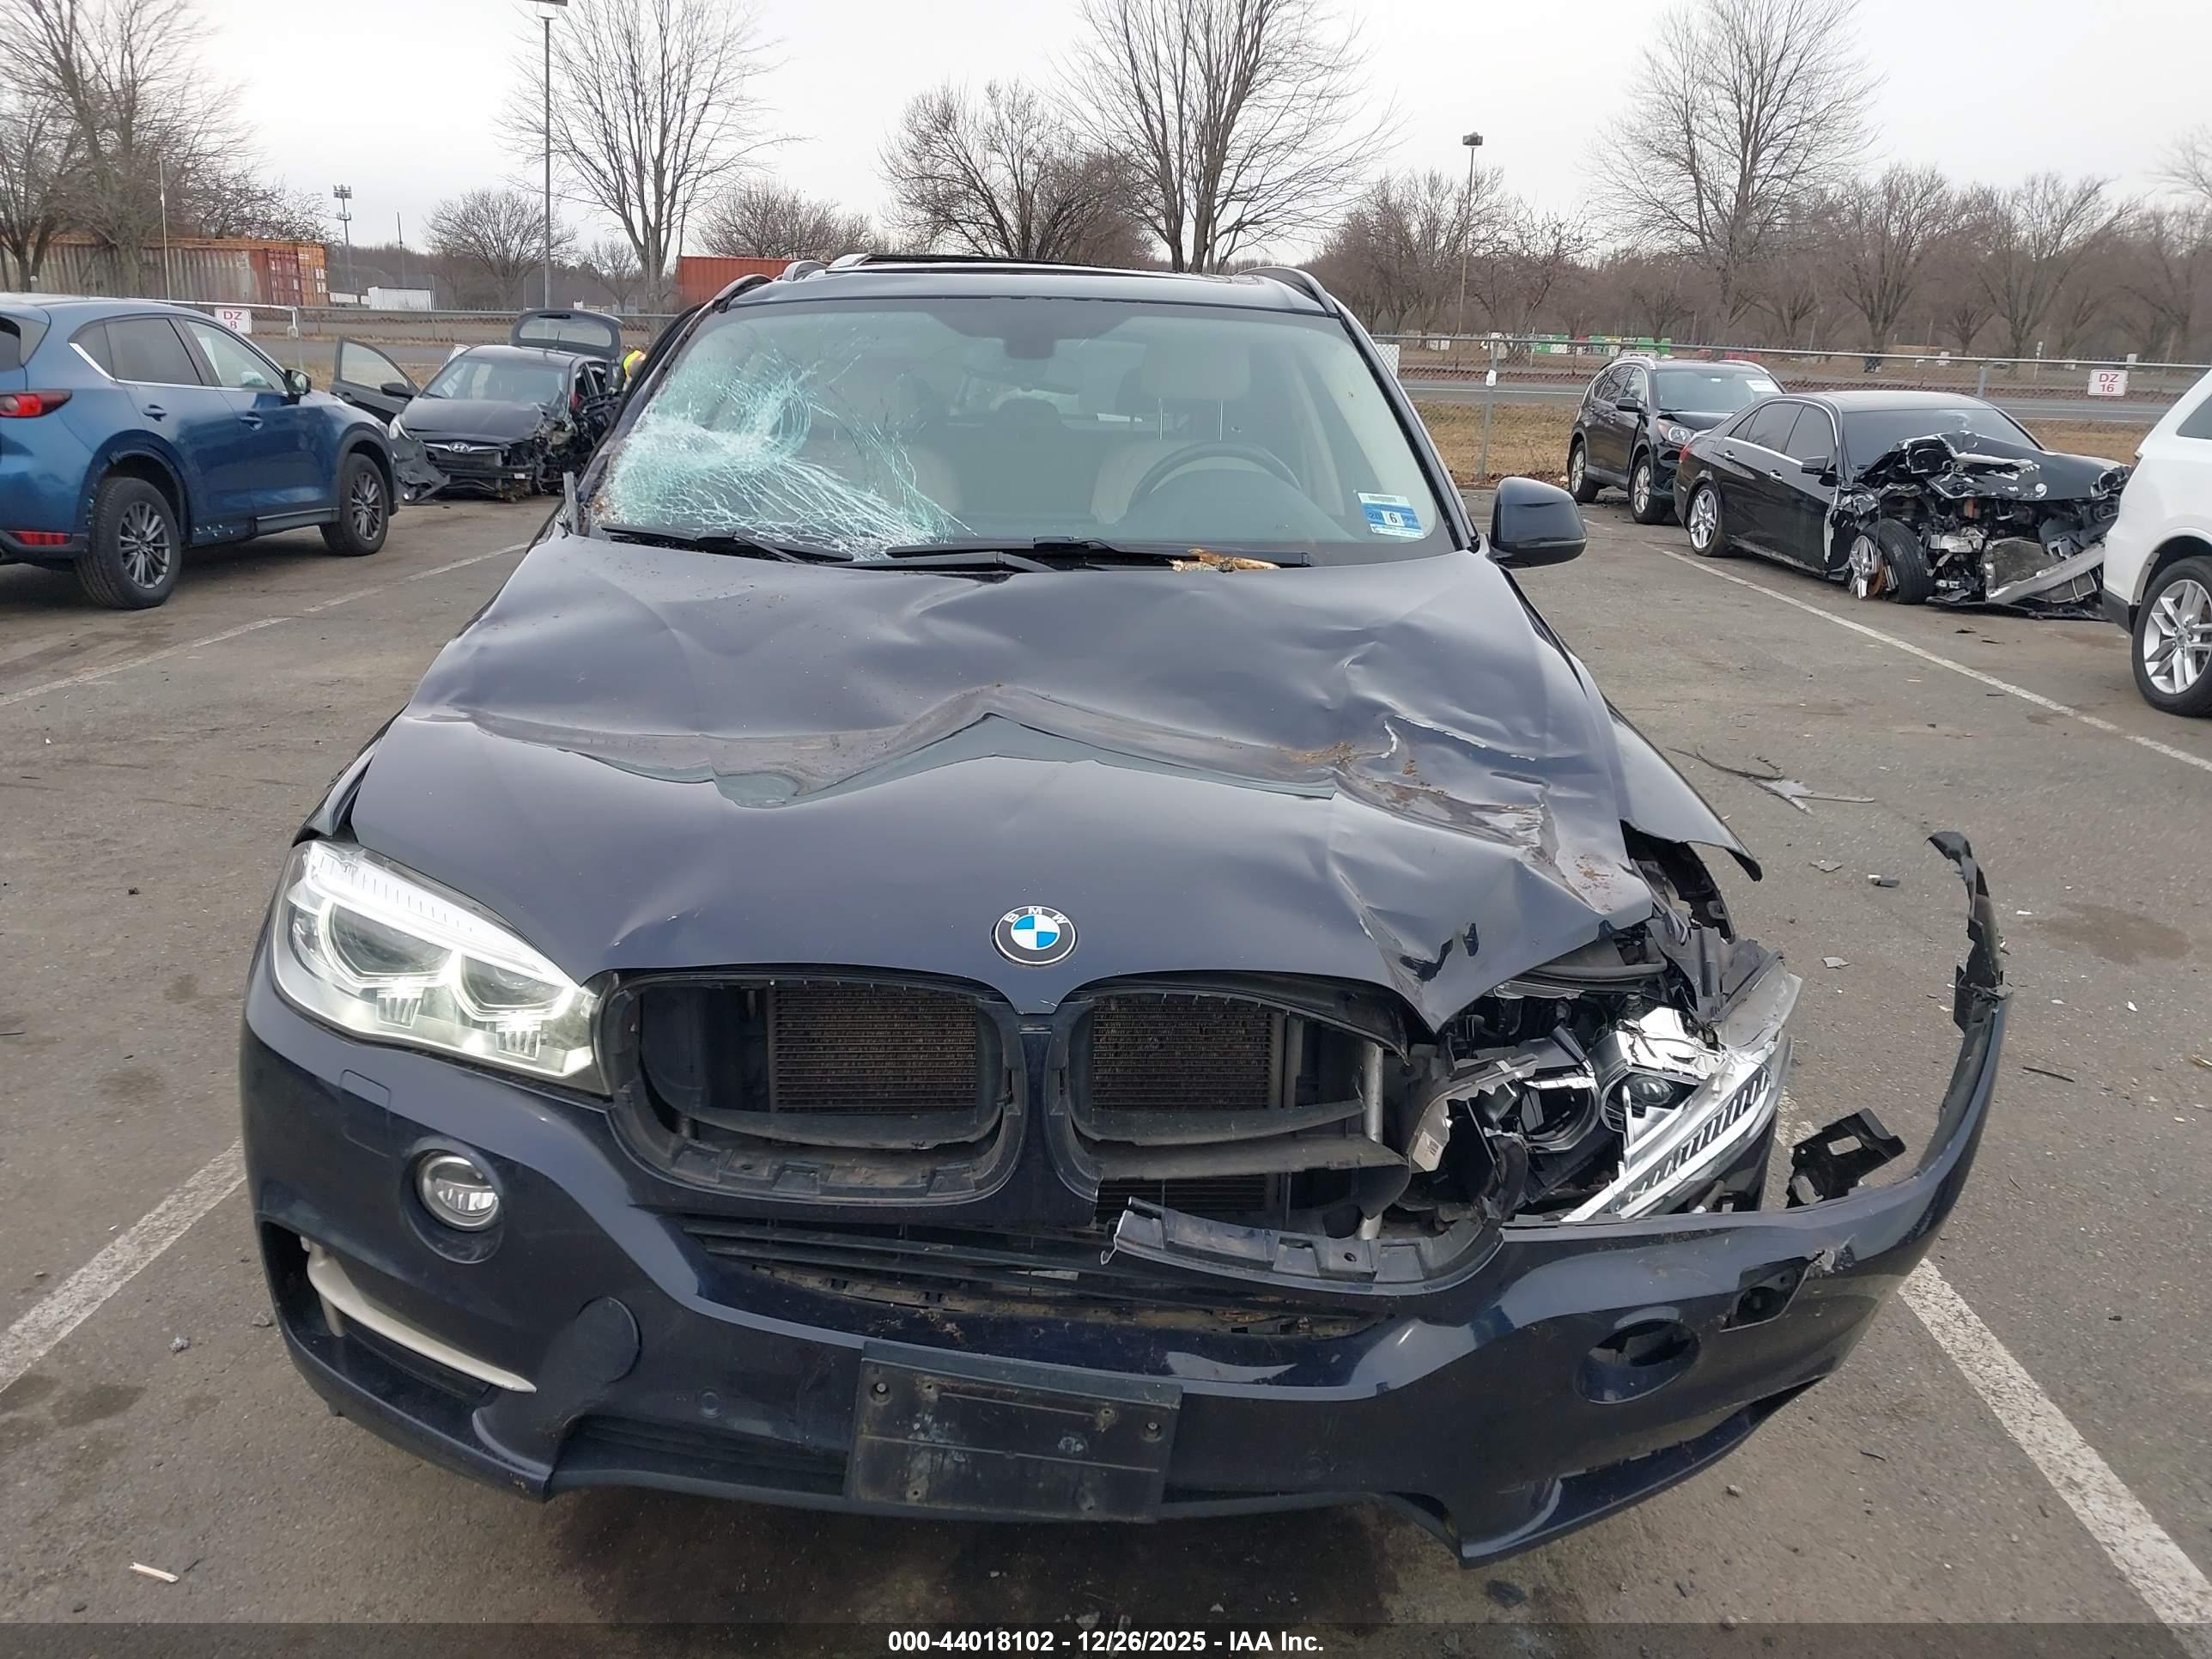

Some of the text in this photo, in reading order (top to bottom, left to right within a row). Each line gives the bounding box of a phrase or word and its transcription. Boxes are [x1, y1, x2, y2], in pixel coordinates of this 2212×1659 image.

[223, 311, 242, 320] DZ
[2099, 373, 2119, 383] DZ
[2100, 384, 2115, 392] 16
[1389, 513, 1398, 524] 6
[1003, 907, 1069, 925] BMW
